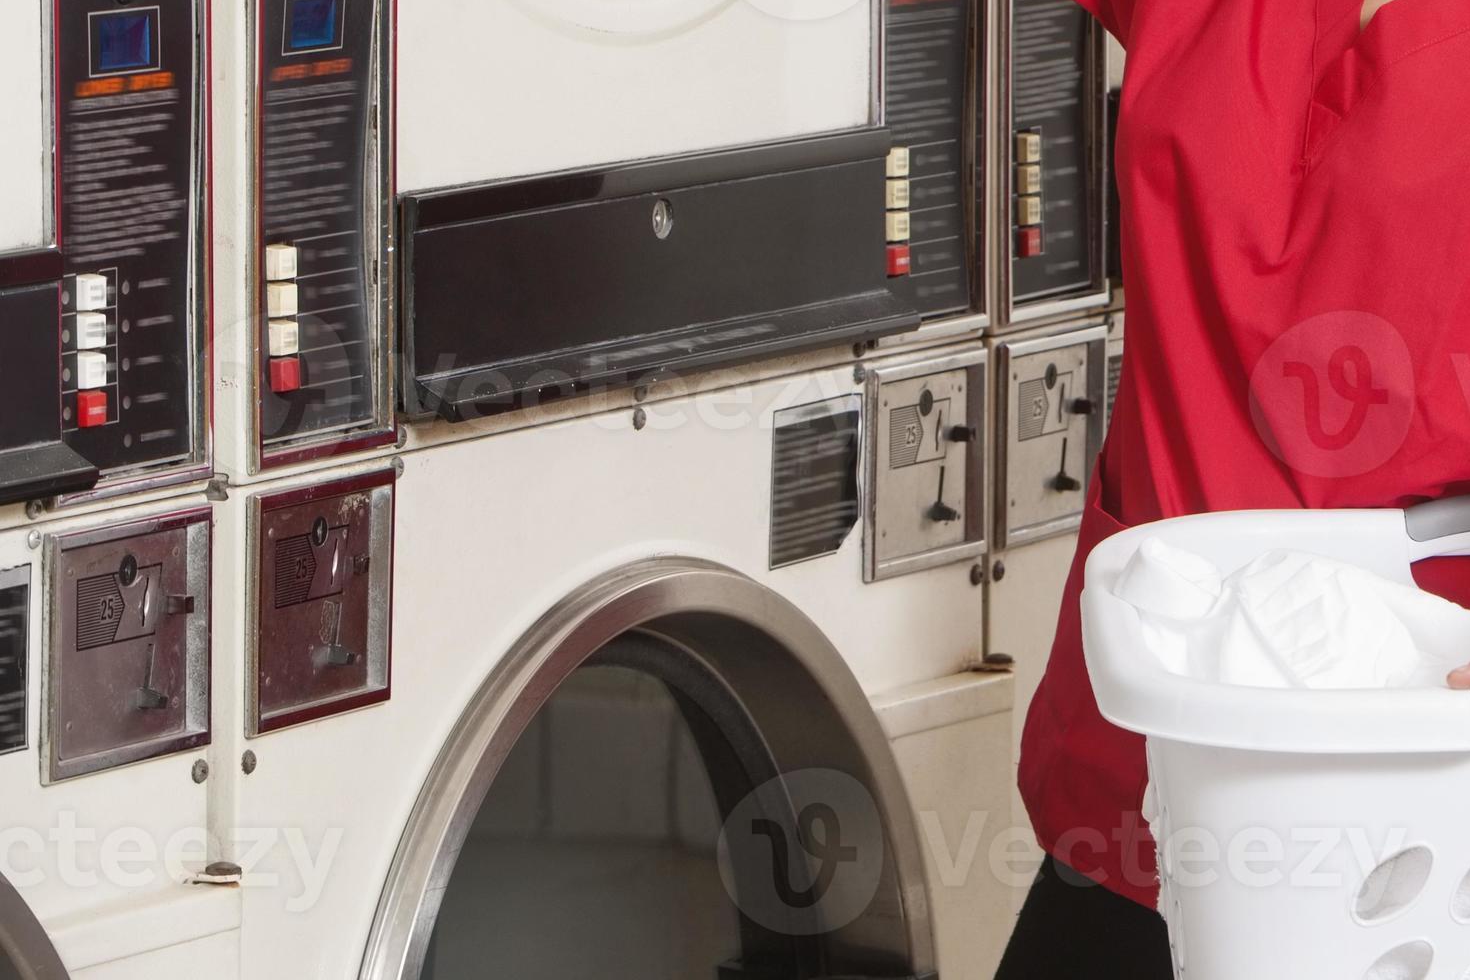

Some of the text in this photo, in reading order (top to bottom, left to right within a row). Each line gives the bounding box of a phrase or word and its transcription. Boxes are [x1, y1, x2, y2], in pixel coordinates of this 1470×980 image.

[905, 425, 916, 446] 25
[294, 557, 308, 580] 25
[100, 597, 115, 621] 25
